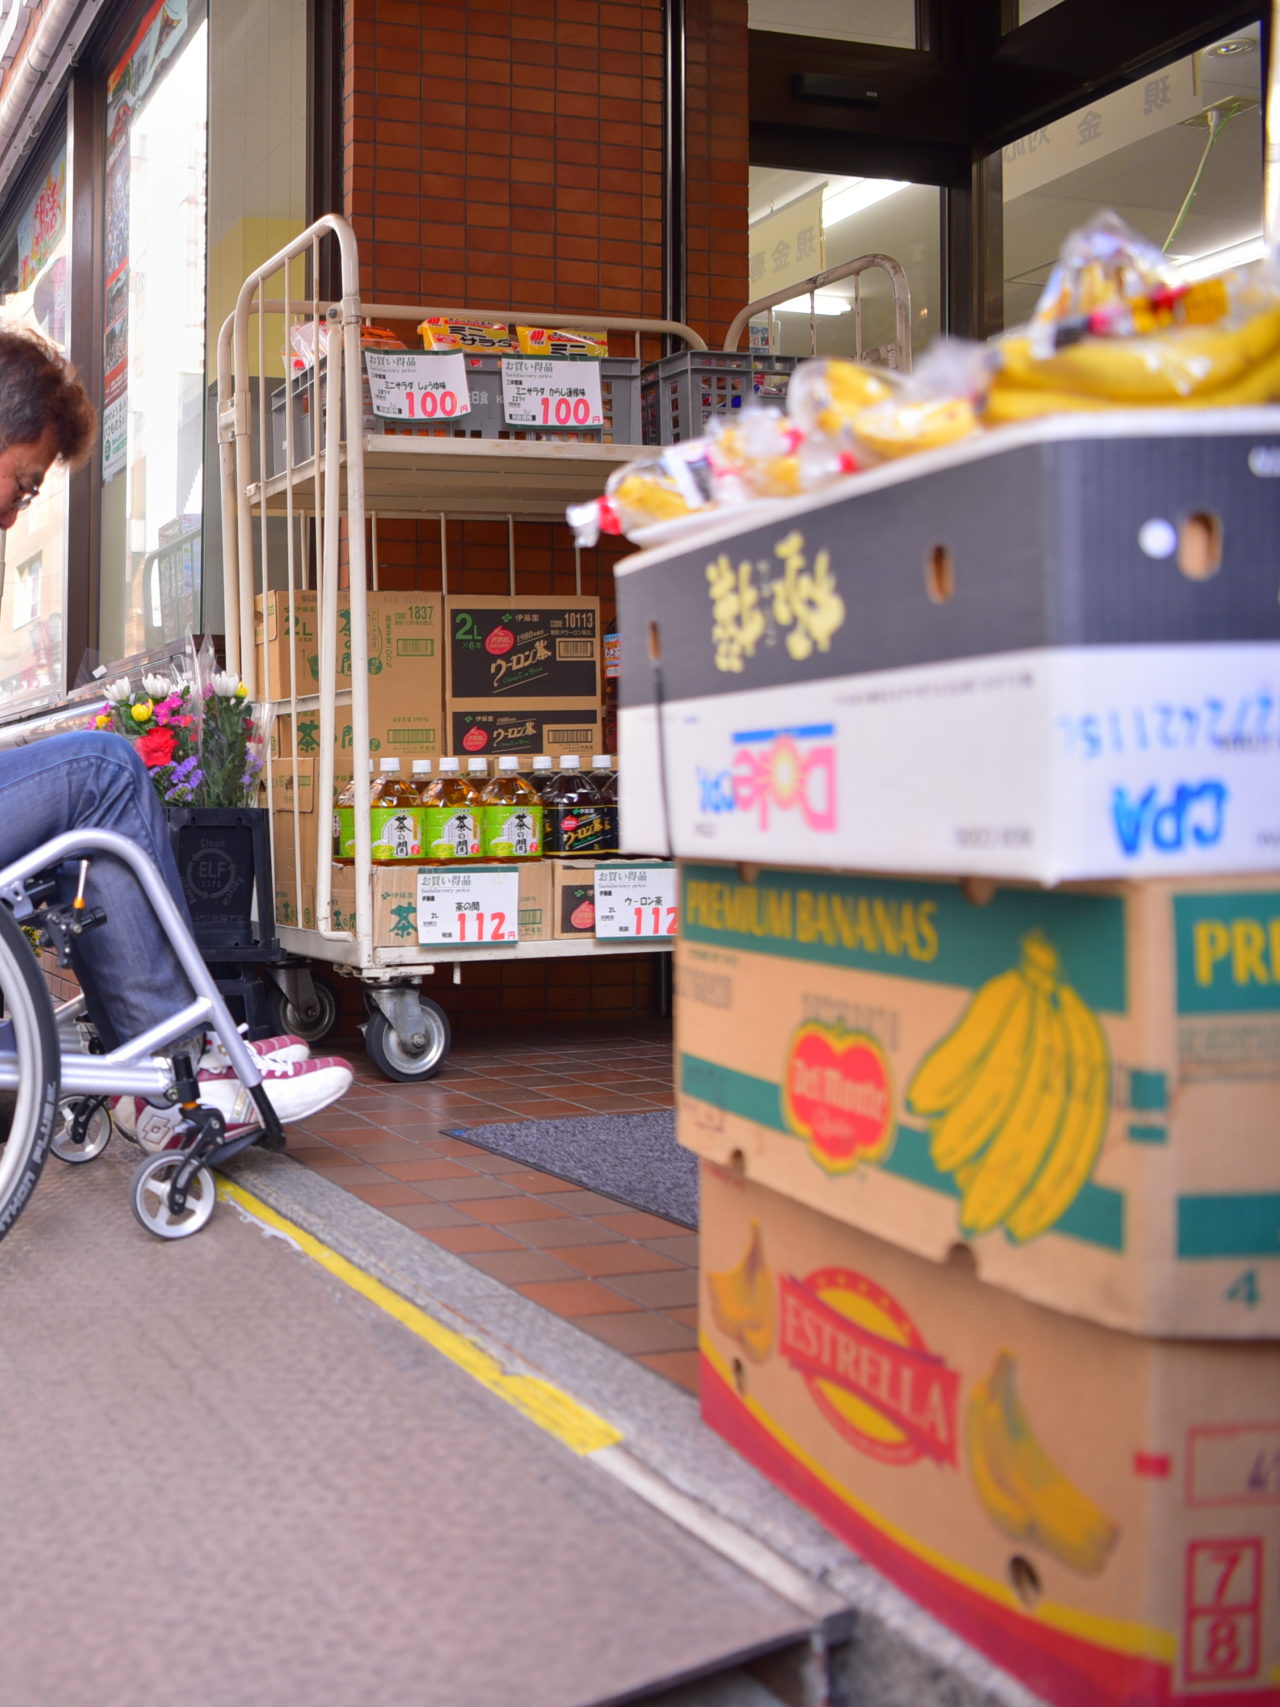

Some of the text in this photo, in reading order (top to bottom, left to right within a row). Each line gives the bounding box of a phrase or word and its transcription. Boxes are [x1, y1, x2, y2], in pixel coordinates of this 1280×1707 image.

[368, 356, 417, 367] お買い得品
[505, 361, 553, 372] お買い得品
[384, 381, 414, 389] ミニサラダ
[469, 391, 488, 405] 日食
[515, 387, 545, 396] ミニサラダ
[405, 391, 458, 418] 100
[541, 397, 591, 425] 100
[408, 606, 434, 620] 1837
[455, 613, 483, 640] 2L
[515, 614, 539, 622] 伊藤園
[564, 612, 593, 628] 10113
[490, 639, 552, 687] ウーロン茶
[493, 722, 537, 747] ウーロン茶
[732, 737, 838, 834] Dole
[1111, 780, 1229, 858] CPA
[394, 814, 412, 856] 茶の間
[454, 814, 472, 856] 茶の間
[514, 813, 532, 854] 茶の間
[200, 861, 227, 878] ELF
[421, 875, 471, 886] お買い得品
[598, 871, 647, 881] お買い得品
[455, 902, 480, 912] 茶の間
[624, 896, 662, 906] ウーロン茶
[457, 912, 506, 941] 112
[634, 906, 678, 935] 112
[687, 879, 939, 963] PREMIUM BANANAS
[825, 1067, 885, 1121] Monte
[785, 1294, 949, 1447] ESTRELLA
[1208, 1551, 1242, 1602] 7
[1207, 1617, 1239, 1666] 8
